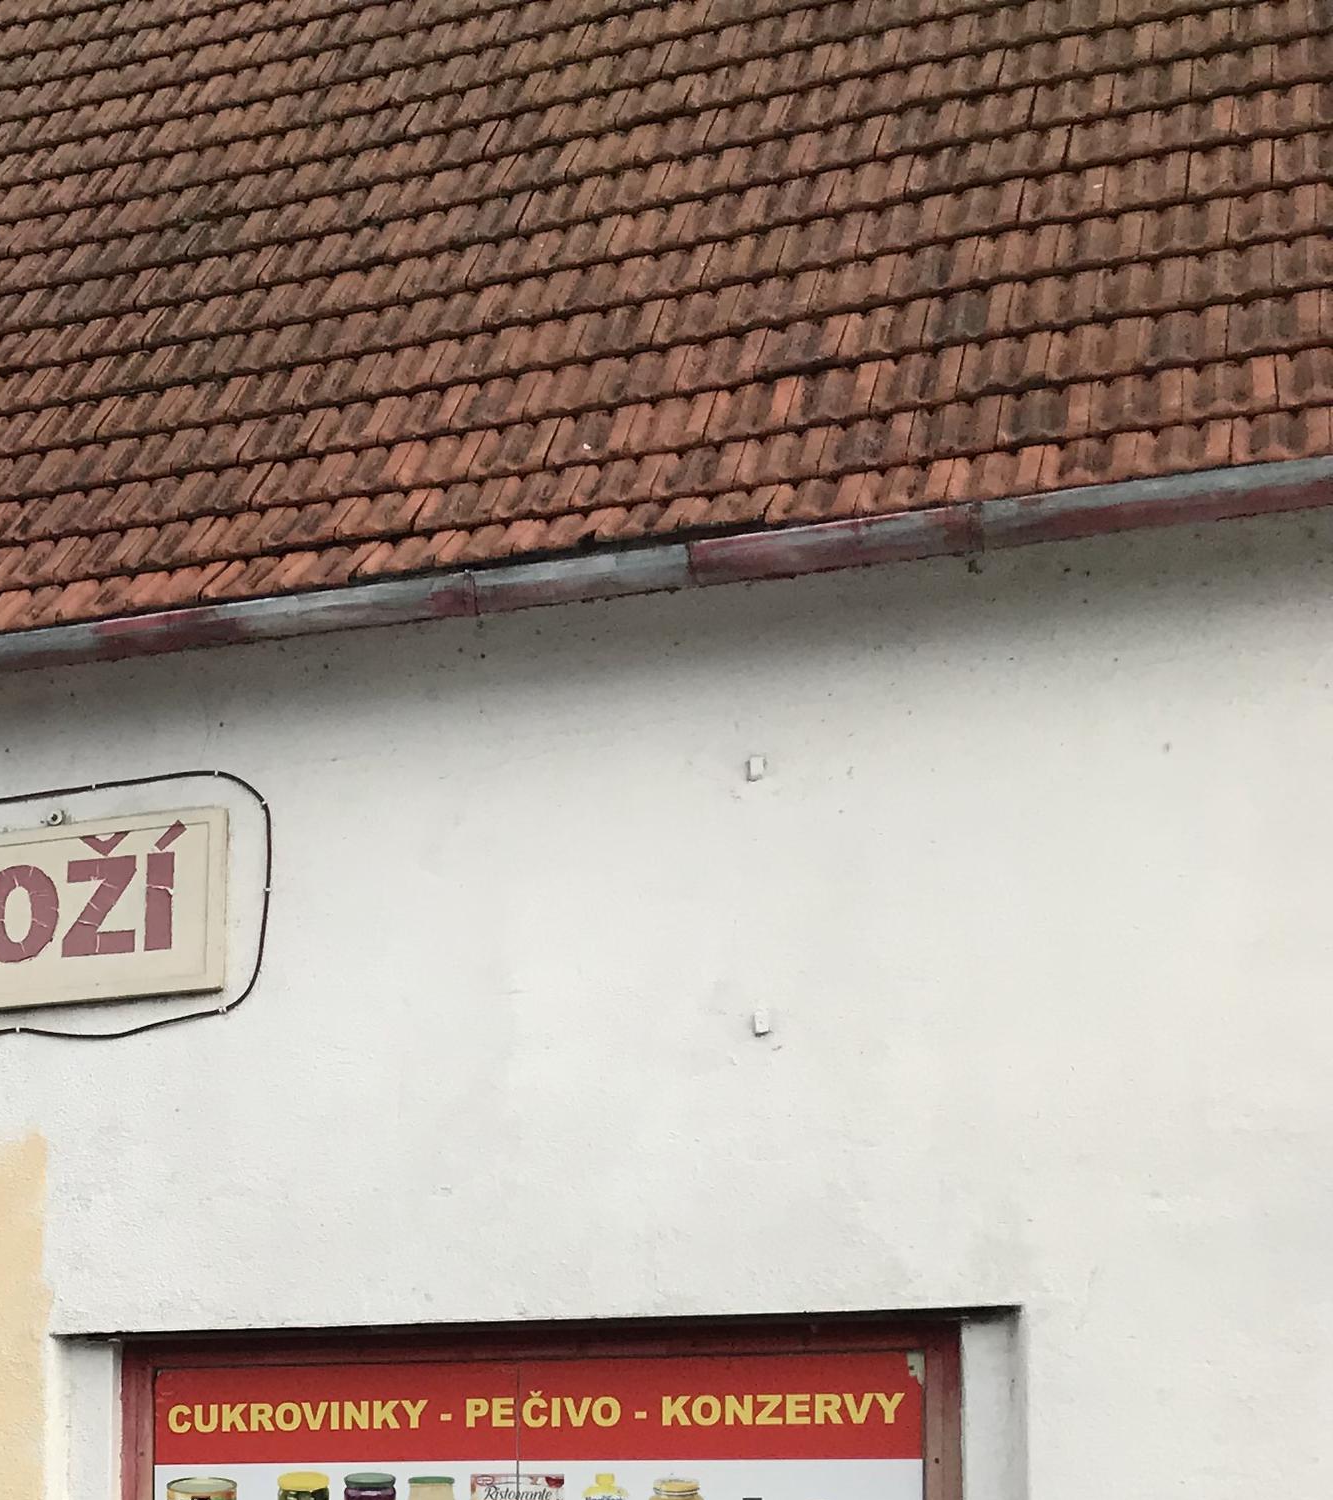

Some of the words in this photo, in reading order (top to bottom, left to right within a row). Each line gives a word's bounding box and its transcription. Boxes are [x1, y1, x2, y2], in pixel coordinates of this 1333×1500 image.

[168, 1399, 429, 1434] CUKROVINKY
[465, 1390, 622, 1429] PEČIVO
[661, 1392, 906, 1427] KONZERVY
